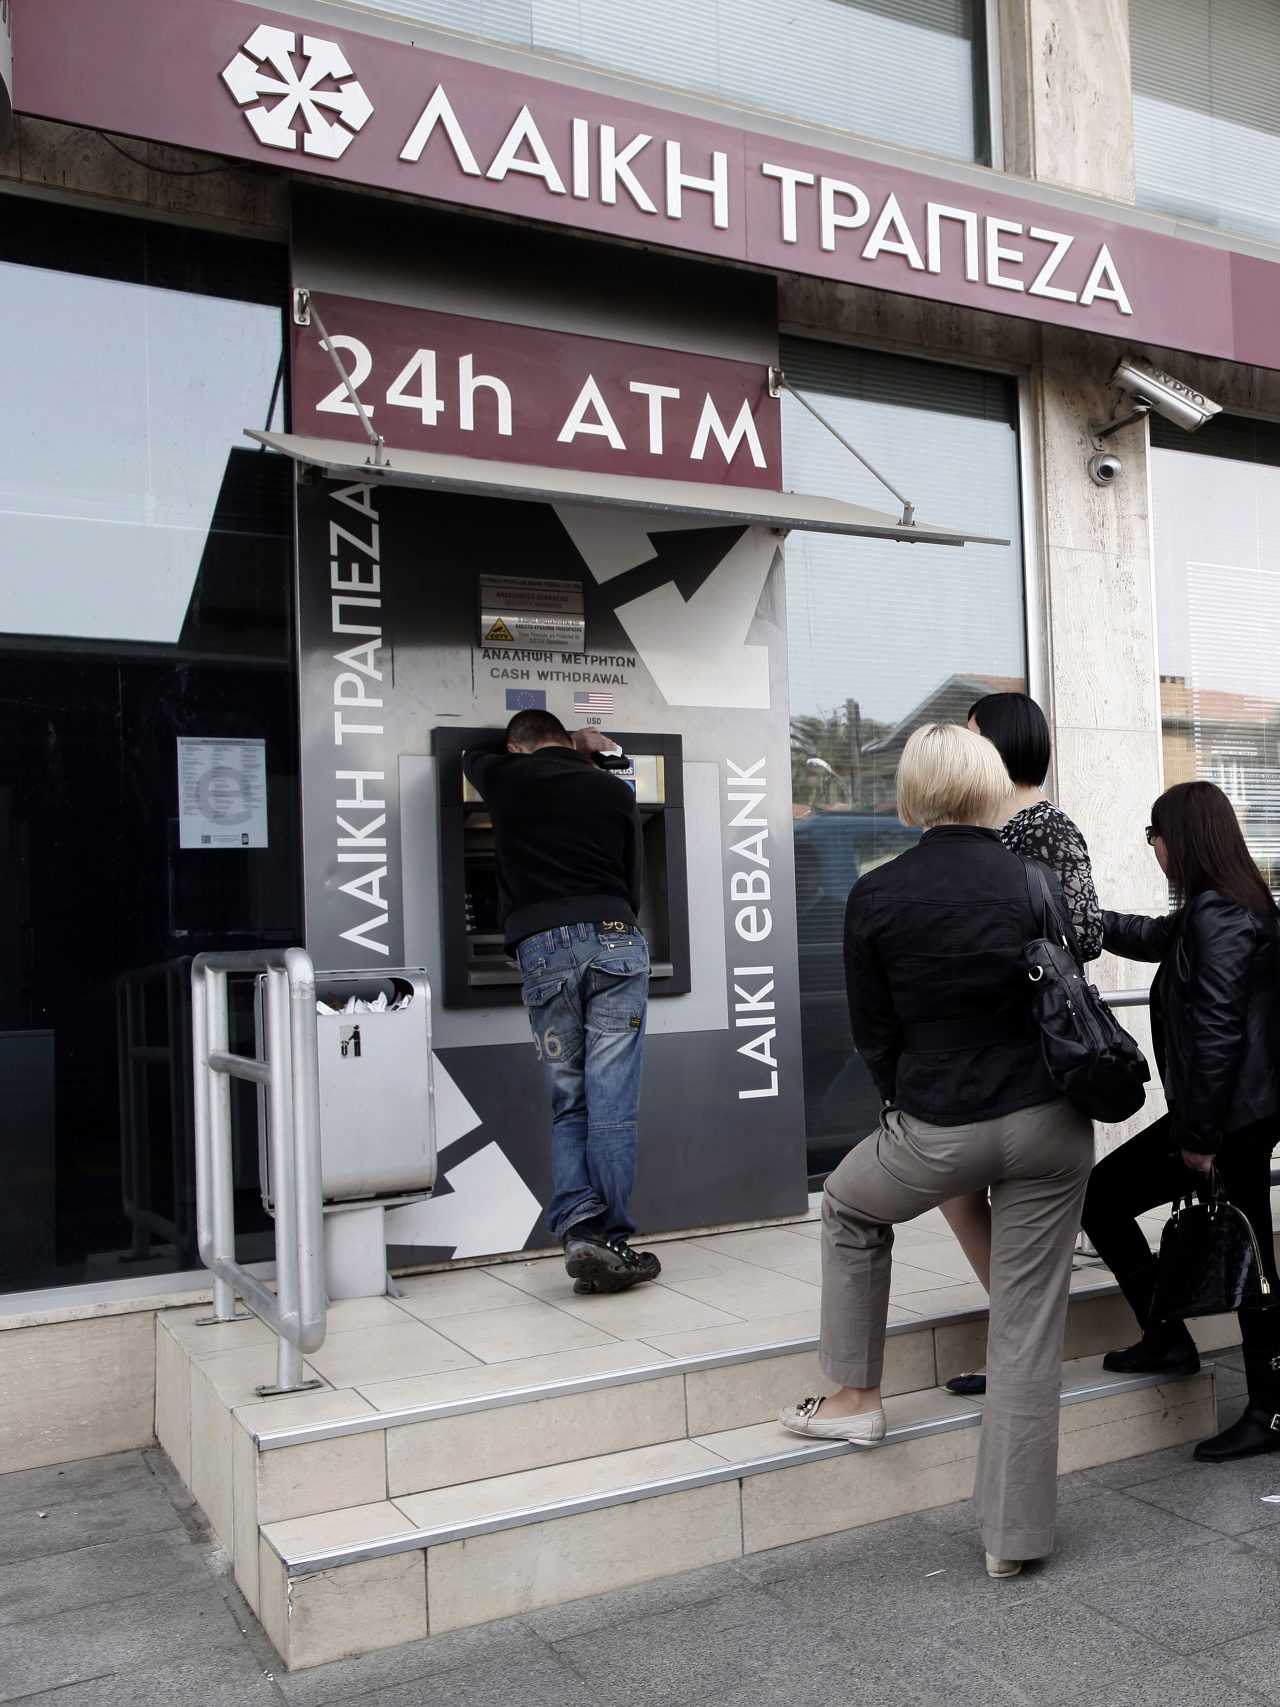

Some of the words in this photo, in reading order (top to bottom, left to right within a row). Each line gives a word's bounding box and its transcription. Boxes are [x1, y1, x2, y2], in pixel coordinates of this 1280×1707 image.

[400, 83, 729, 229] ΛΑΙΚΗ
[762, 162, 1134, 315] ΤΡΑΠΕΖΑ
[315, 334, 513, 436] 24h
[556, 373, 768, 469] ATM
[328, 482, 384, 746] ΤΡΑΠΕΖΑ
[481, 649, 553, 663] ΑΝΑΛΗΨΗ
[561, 653, 636, 668] ΜΕΤΡΗΤΩΝ
[490, 667, 530, 680] CASH
[537, 670, 629, 685] WITHDRAWAL
[586, 717, 602, 725] USD
[335, 769, 390, 956] ΛΑΙΚΗ
[727, 756, 773, 942] eBANK
[733, 965, 779, 1099] LAIKI
